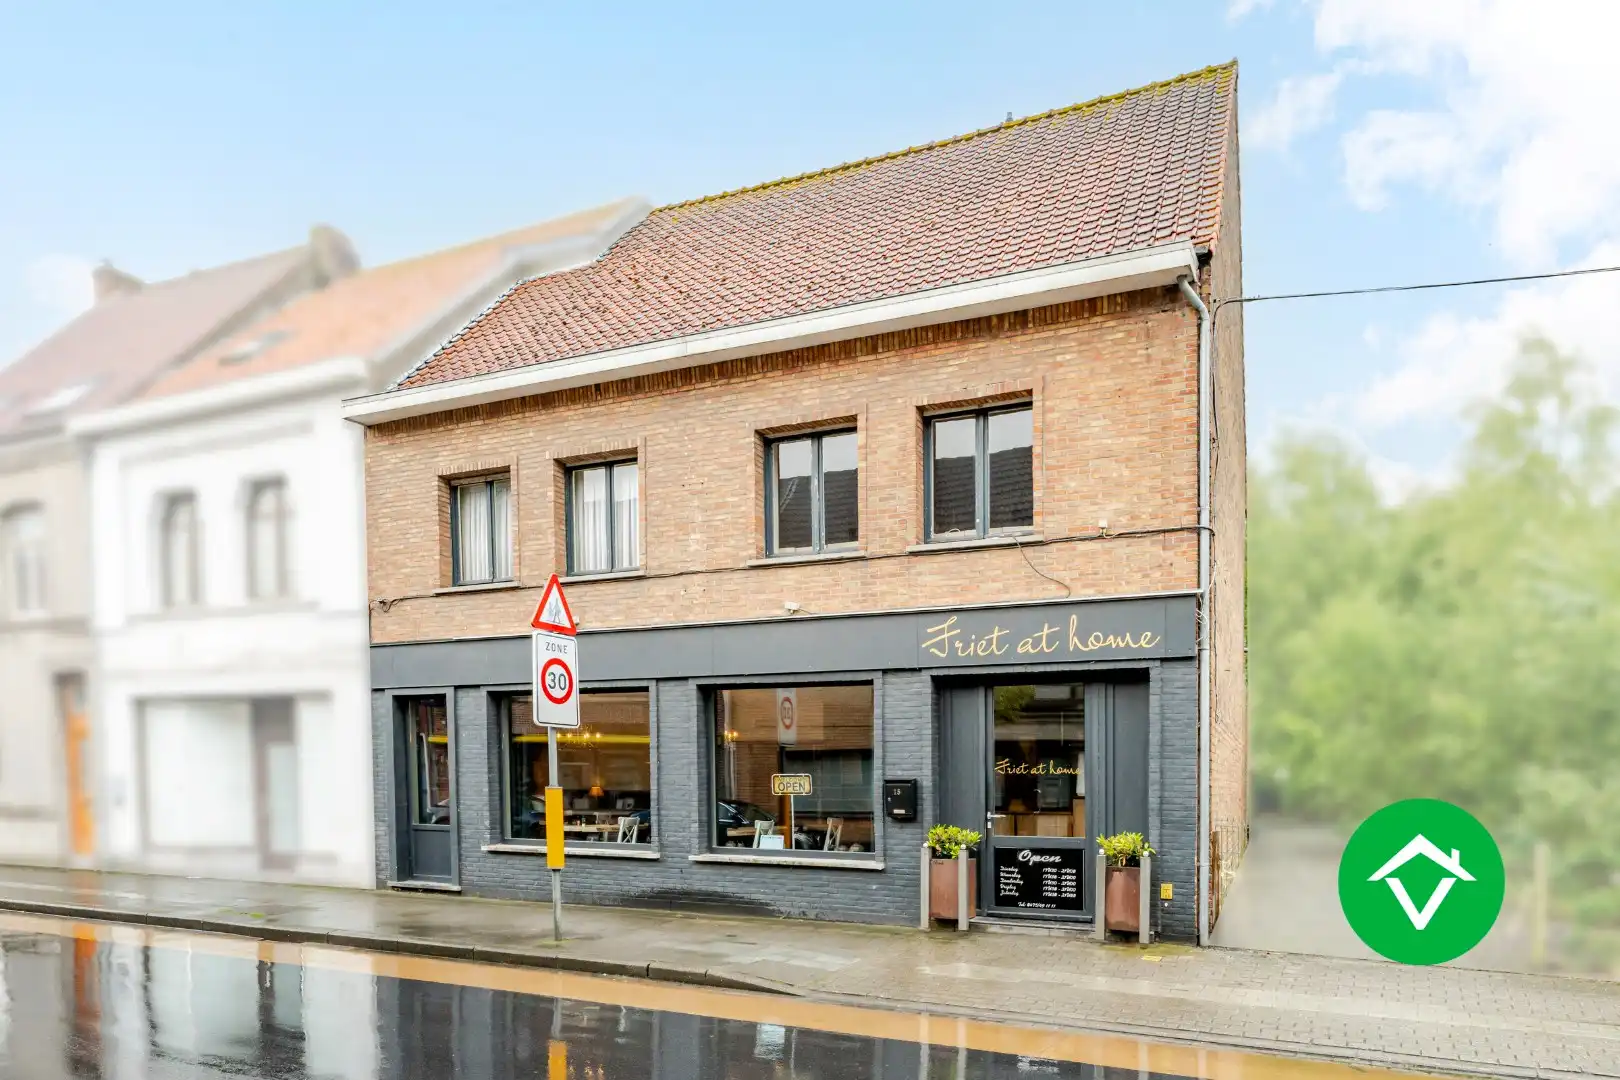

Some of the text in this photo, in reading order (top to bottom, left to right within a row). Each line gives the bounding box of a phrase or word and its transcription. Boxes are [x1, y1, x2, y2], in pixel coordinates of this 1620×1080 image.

[922, 614, 1160, 658] Friet at home
[545, 641, 568, 654] ZONE
[548, 671, 567, 691] 30
[994, 758, 1081, 775] Friet at home
[777, 782, 806, 792] OPEN
[1018, 849, 1062, 866] Open
